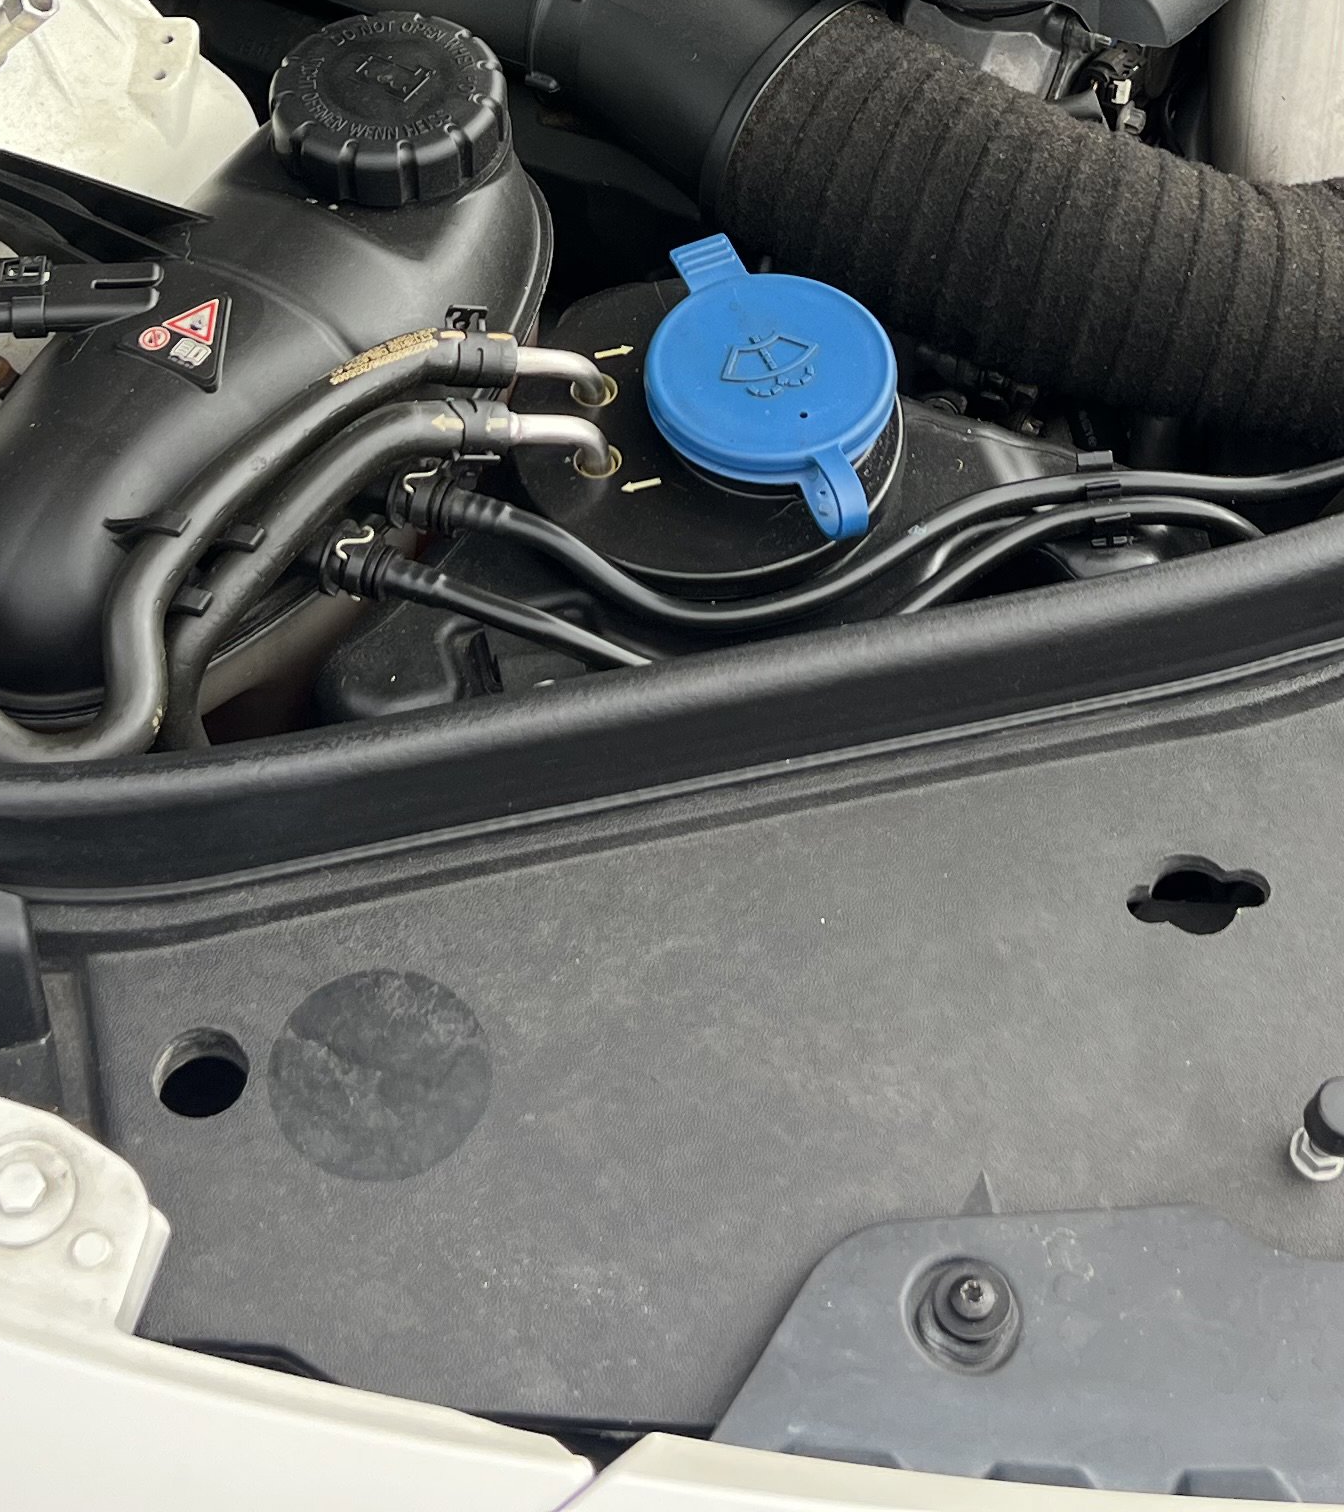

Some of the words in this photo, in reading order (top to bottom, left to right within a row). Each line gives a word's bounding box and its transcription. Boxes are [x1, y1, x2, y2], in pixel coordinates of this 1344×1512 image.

[362, 19, 396, 37] NOT
[401, 20, 448, 43] OPEN
[349, 121, 400, 141] WENN
